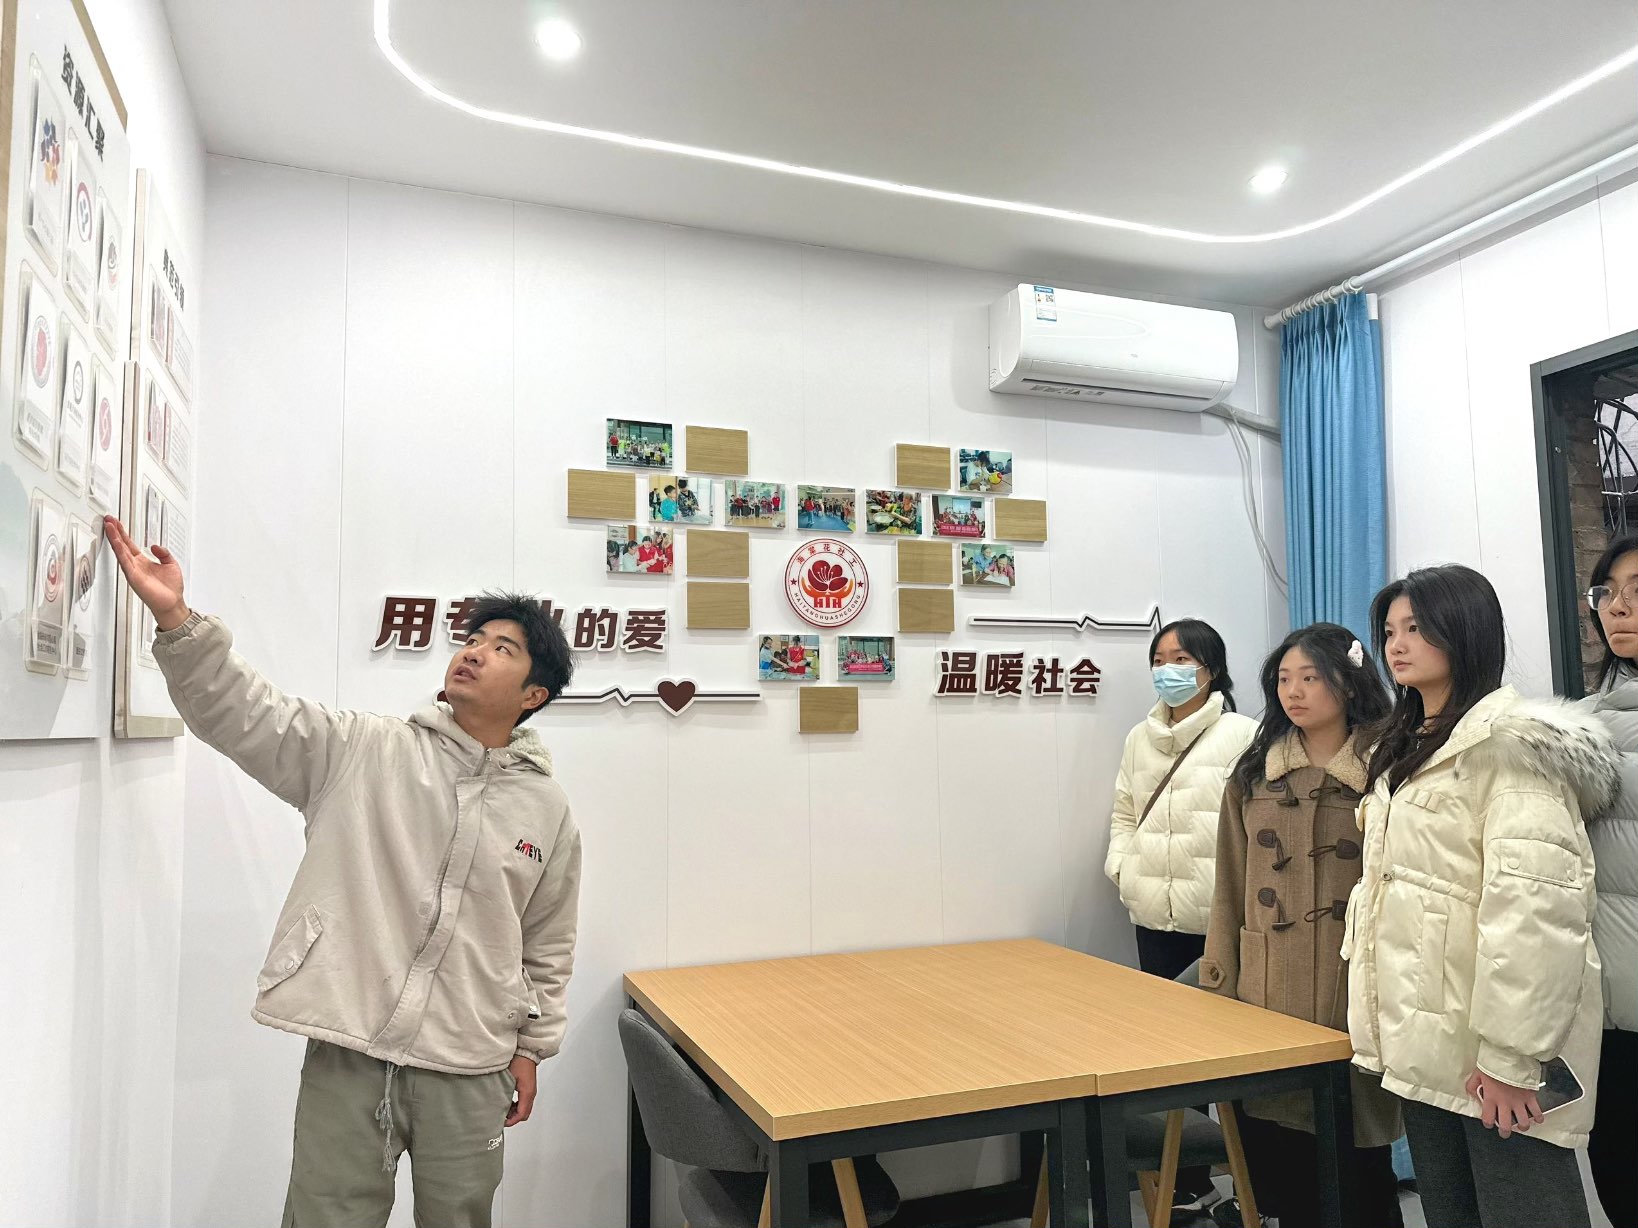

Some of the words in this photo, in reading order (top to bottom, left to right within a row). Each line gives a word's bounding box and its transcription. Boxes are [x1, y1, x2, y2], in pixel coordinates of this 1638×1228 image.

[61, 44, 105, 162] 资源汇聚
[937, 651, 1101, 695] 温暖社会
